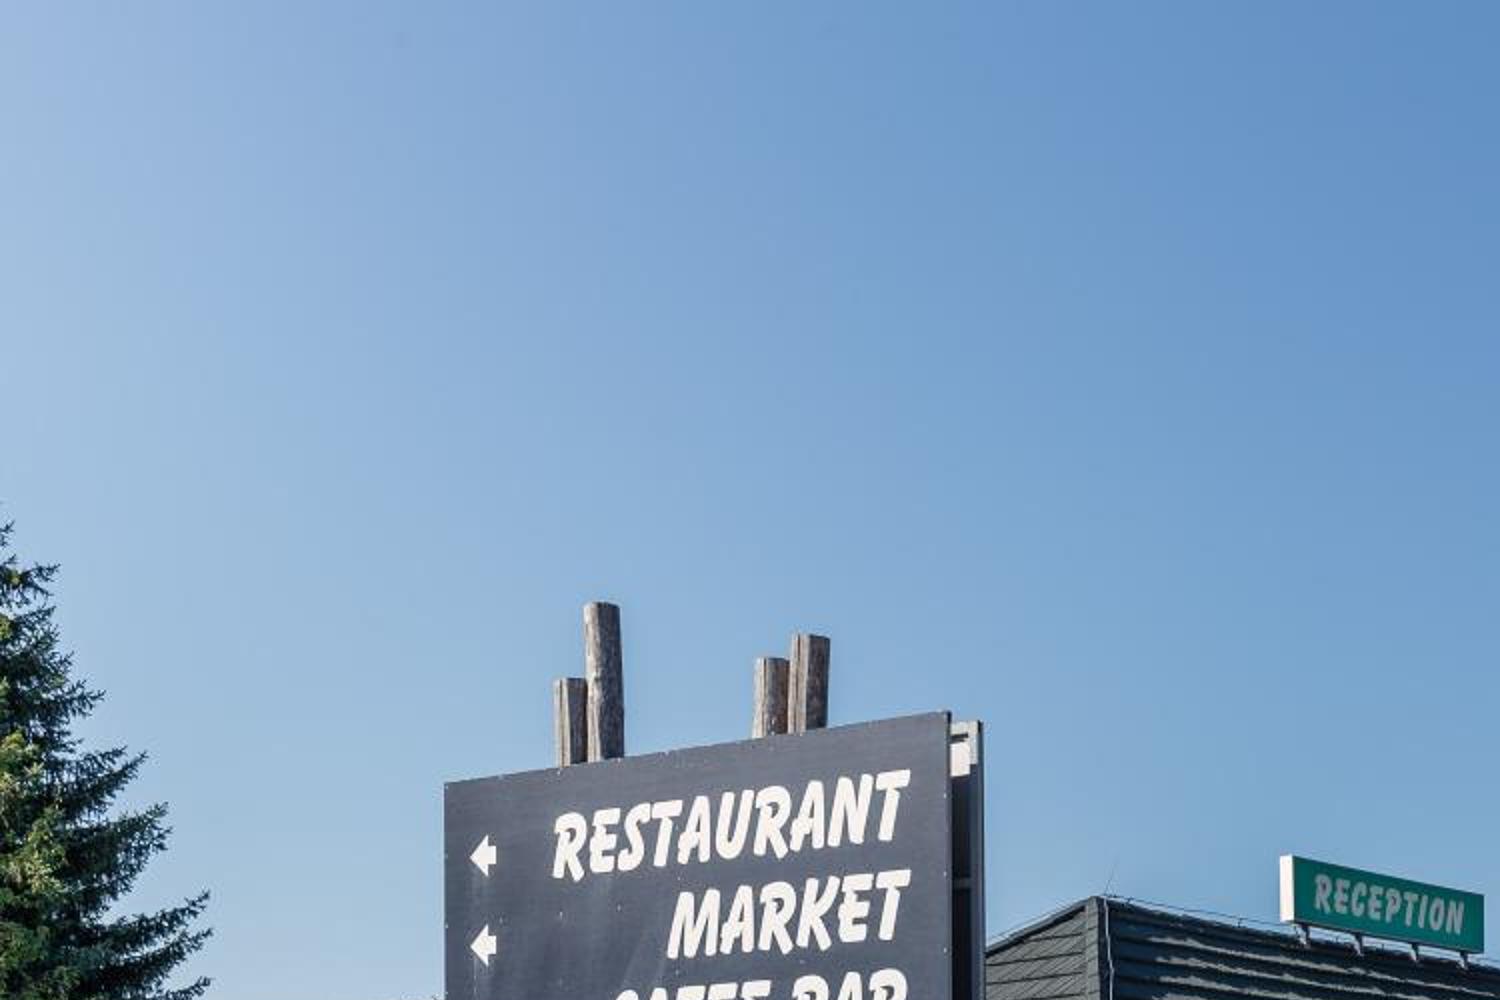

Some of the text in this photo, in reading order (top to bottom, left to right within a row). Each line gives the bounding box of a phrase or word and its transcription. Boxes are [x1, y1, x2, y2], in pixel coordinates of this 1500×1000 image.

[552, 769, 911, 882] RESTAURANT
[667, 869, 911, 959] MARKET
[1314, 873, 1466, 935] RECEPTION
